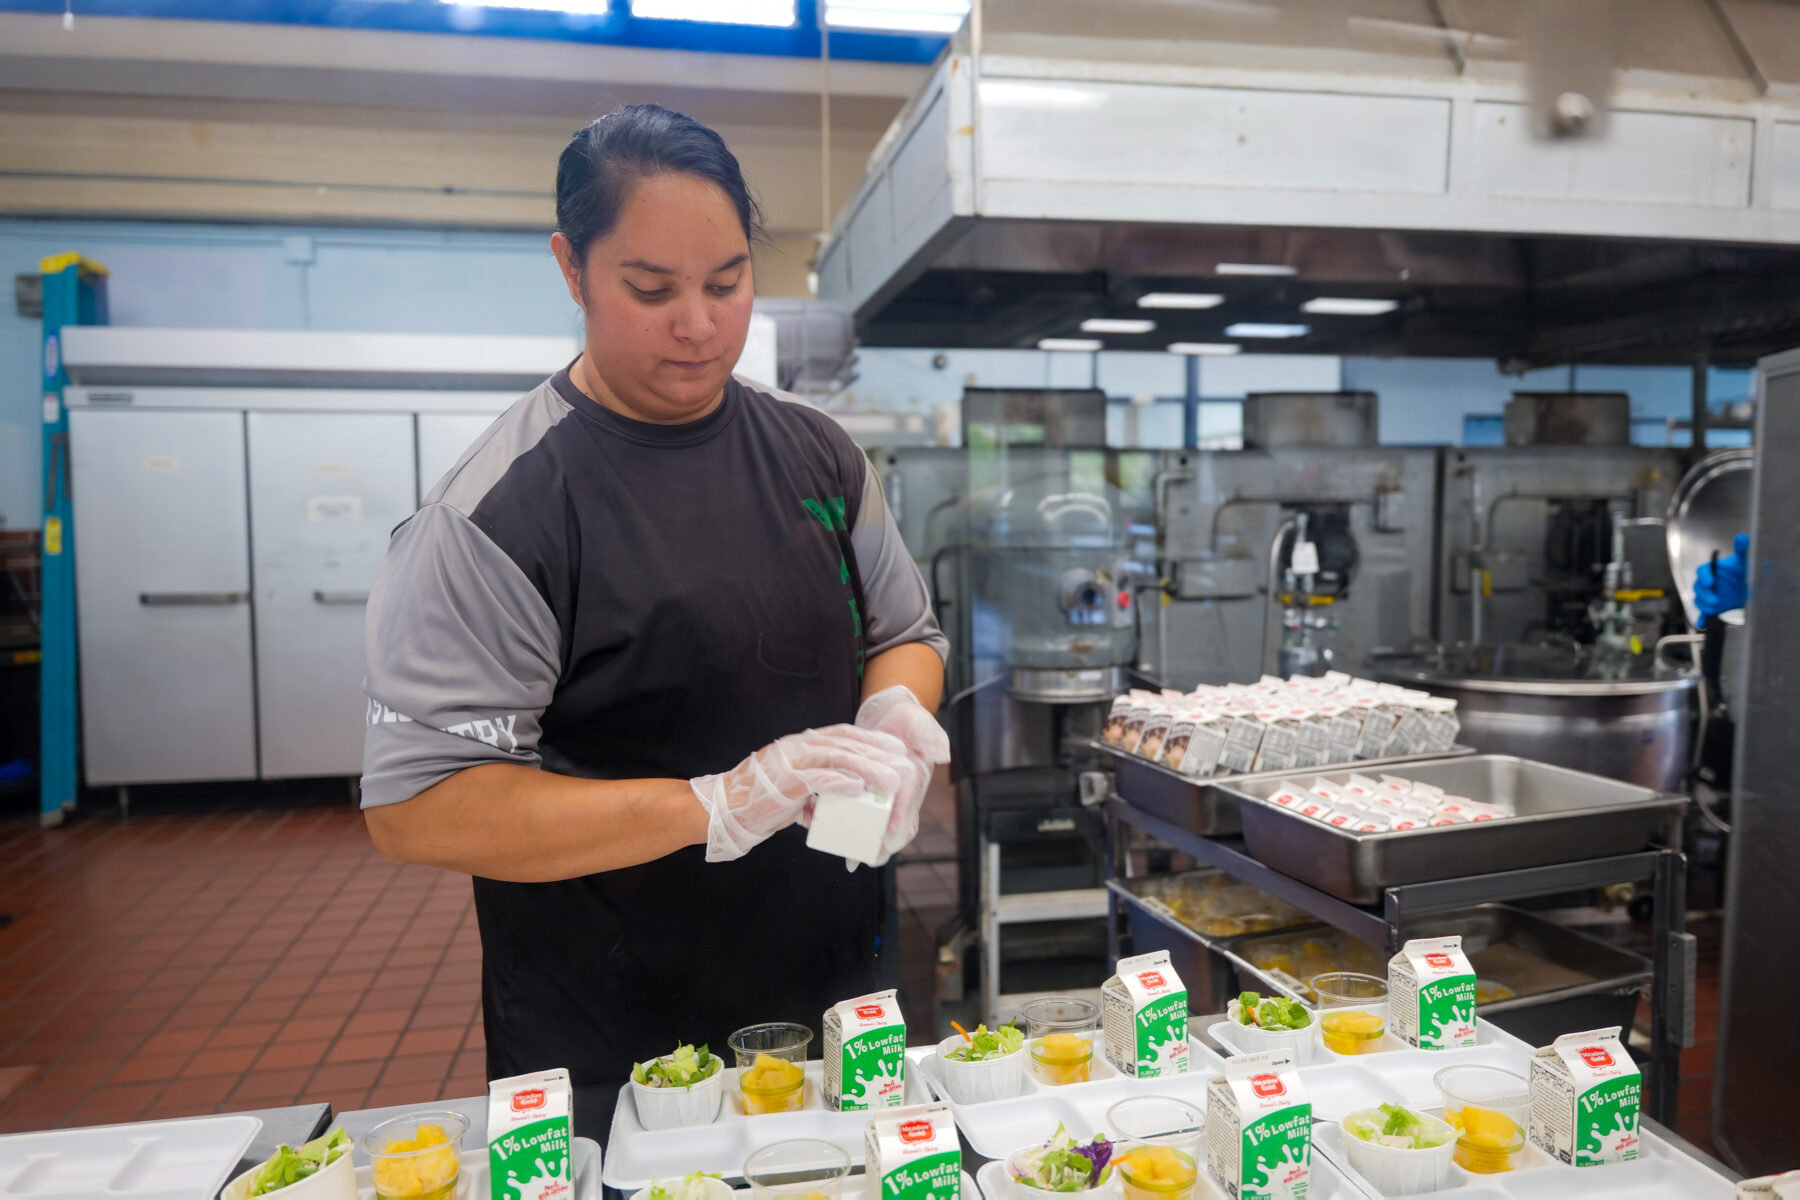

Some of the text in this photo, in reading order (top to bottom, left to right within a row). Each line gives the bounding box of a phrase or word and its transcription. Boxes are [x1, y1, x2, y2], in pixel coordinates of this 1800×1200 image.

[1421, 982, 1475, 1004] 1% Lowfat
[1456, 992, 1475, 1002] Milk
[1137, 999, 1187, 1028] 1% Lowfat
[1170, 1010, 1187, 1022] Milk
[844, 1033, 904, 1060] 1% Lowfat
[882, 1044, 903, 1056] Milk
[1253, 1078, 1278, 1086] Meadow
[1580, 1084, 1640, 1114] 1% Lowfat
[1619, 1095, 1640, 1108] Milk
[1245, 1115, 1310, 1146] 1% Lowfat
[1287, 1126, 1310, 1140] Milk
[492, 1126, 568, 1160] 1% Lowfat
[540, 1140, 568, 1154] Milk
[884, 1161, 959, 1196] 1% Lowfat
[932, 1174, 959, 1189] Milk
